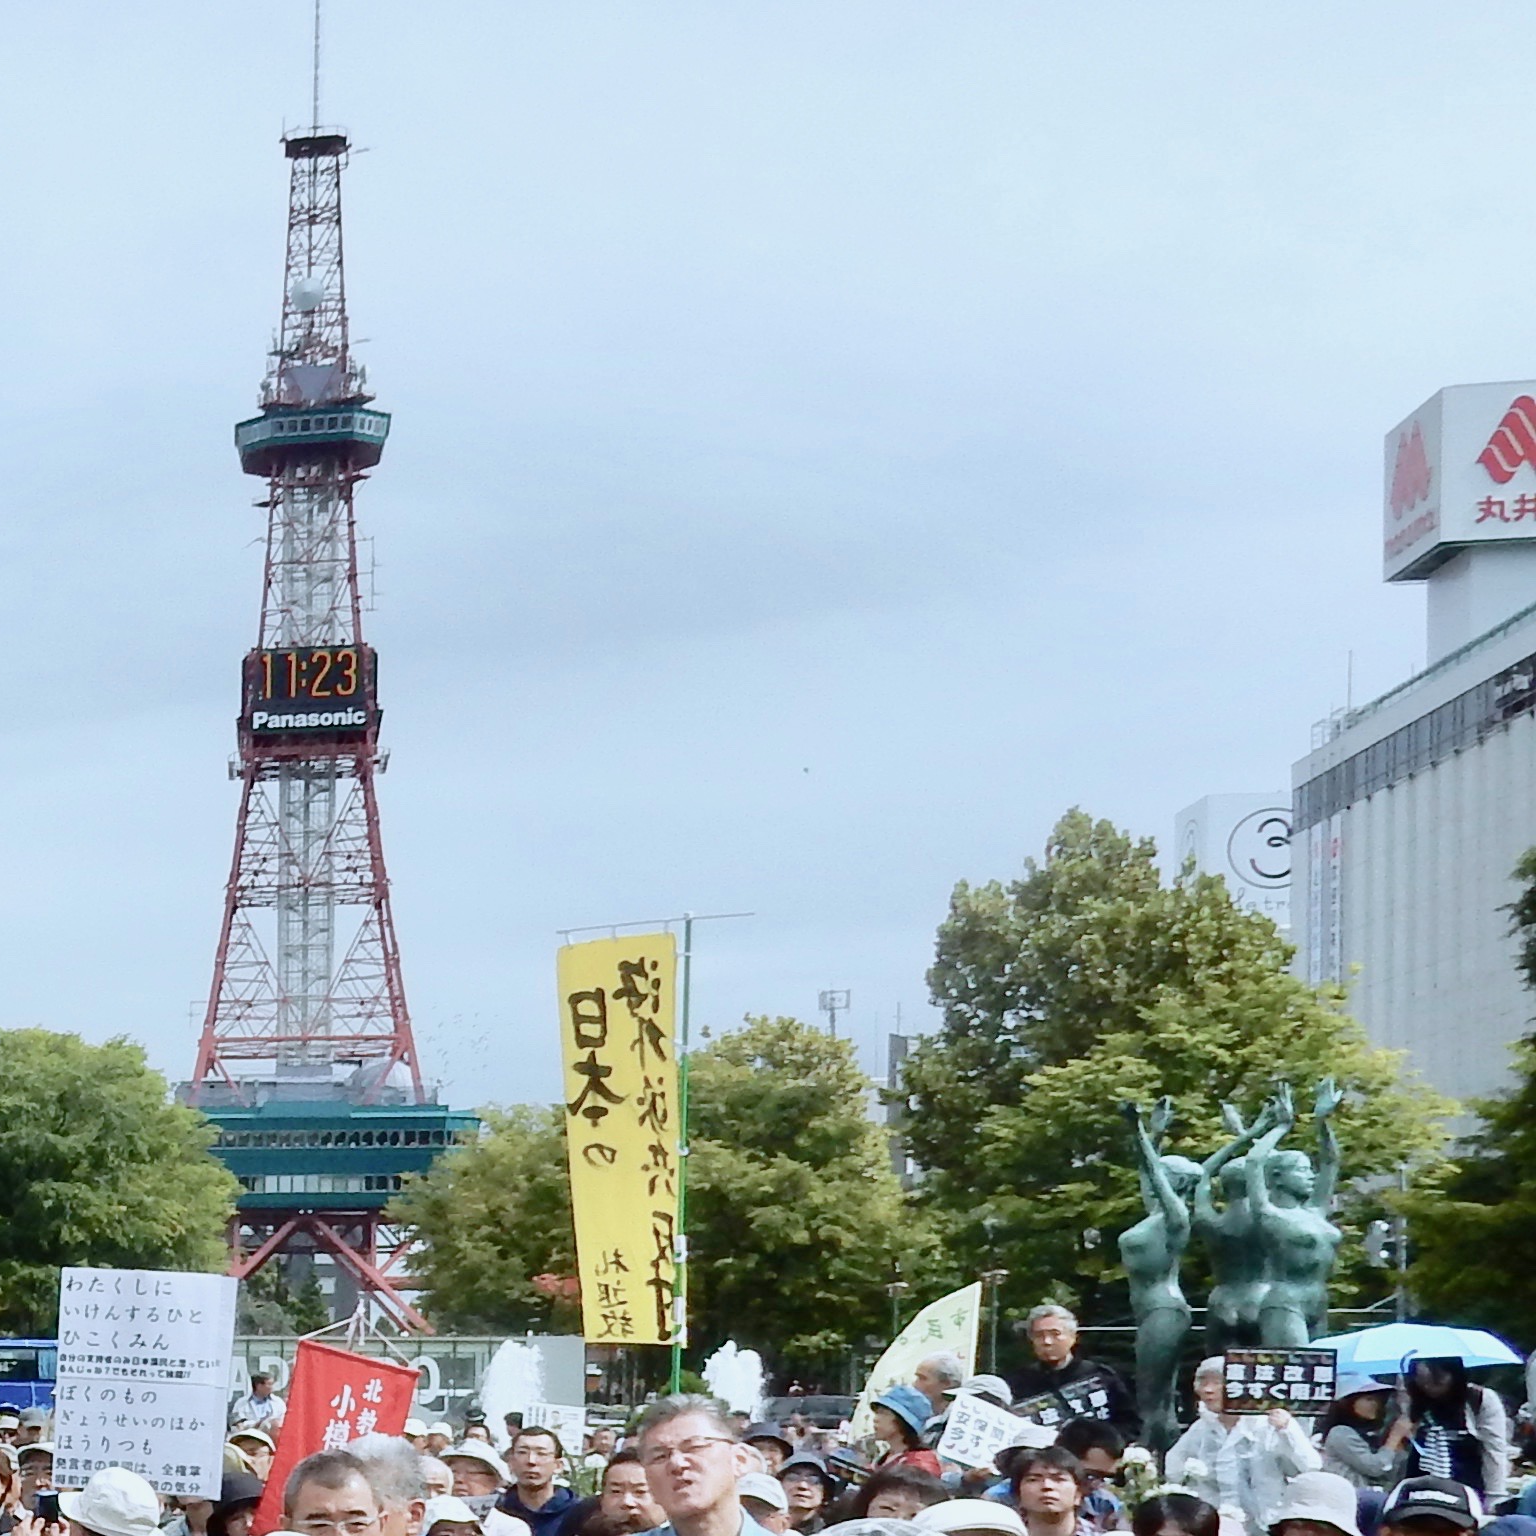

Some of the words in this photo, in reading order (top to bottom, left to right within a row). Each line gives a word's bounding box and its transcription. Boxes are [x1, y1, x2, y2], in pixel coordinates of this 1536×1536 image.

[262, 651, 357, 699] 11:23
[252, 706, 367, 730] Panasonic
[65, 1277, 173, 1296] わたくしに
[64, 1304, 203, 1325] いけんするひと
[63, 1330, 169, 1350] ひこくみん
[60, 1385, 157, 1404] ぼくのもの
[60, 1409, 205, 1431] ぎょうせいのほか
[58, 1434, 153, 1455] ほうりつも
